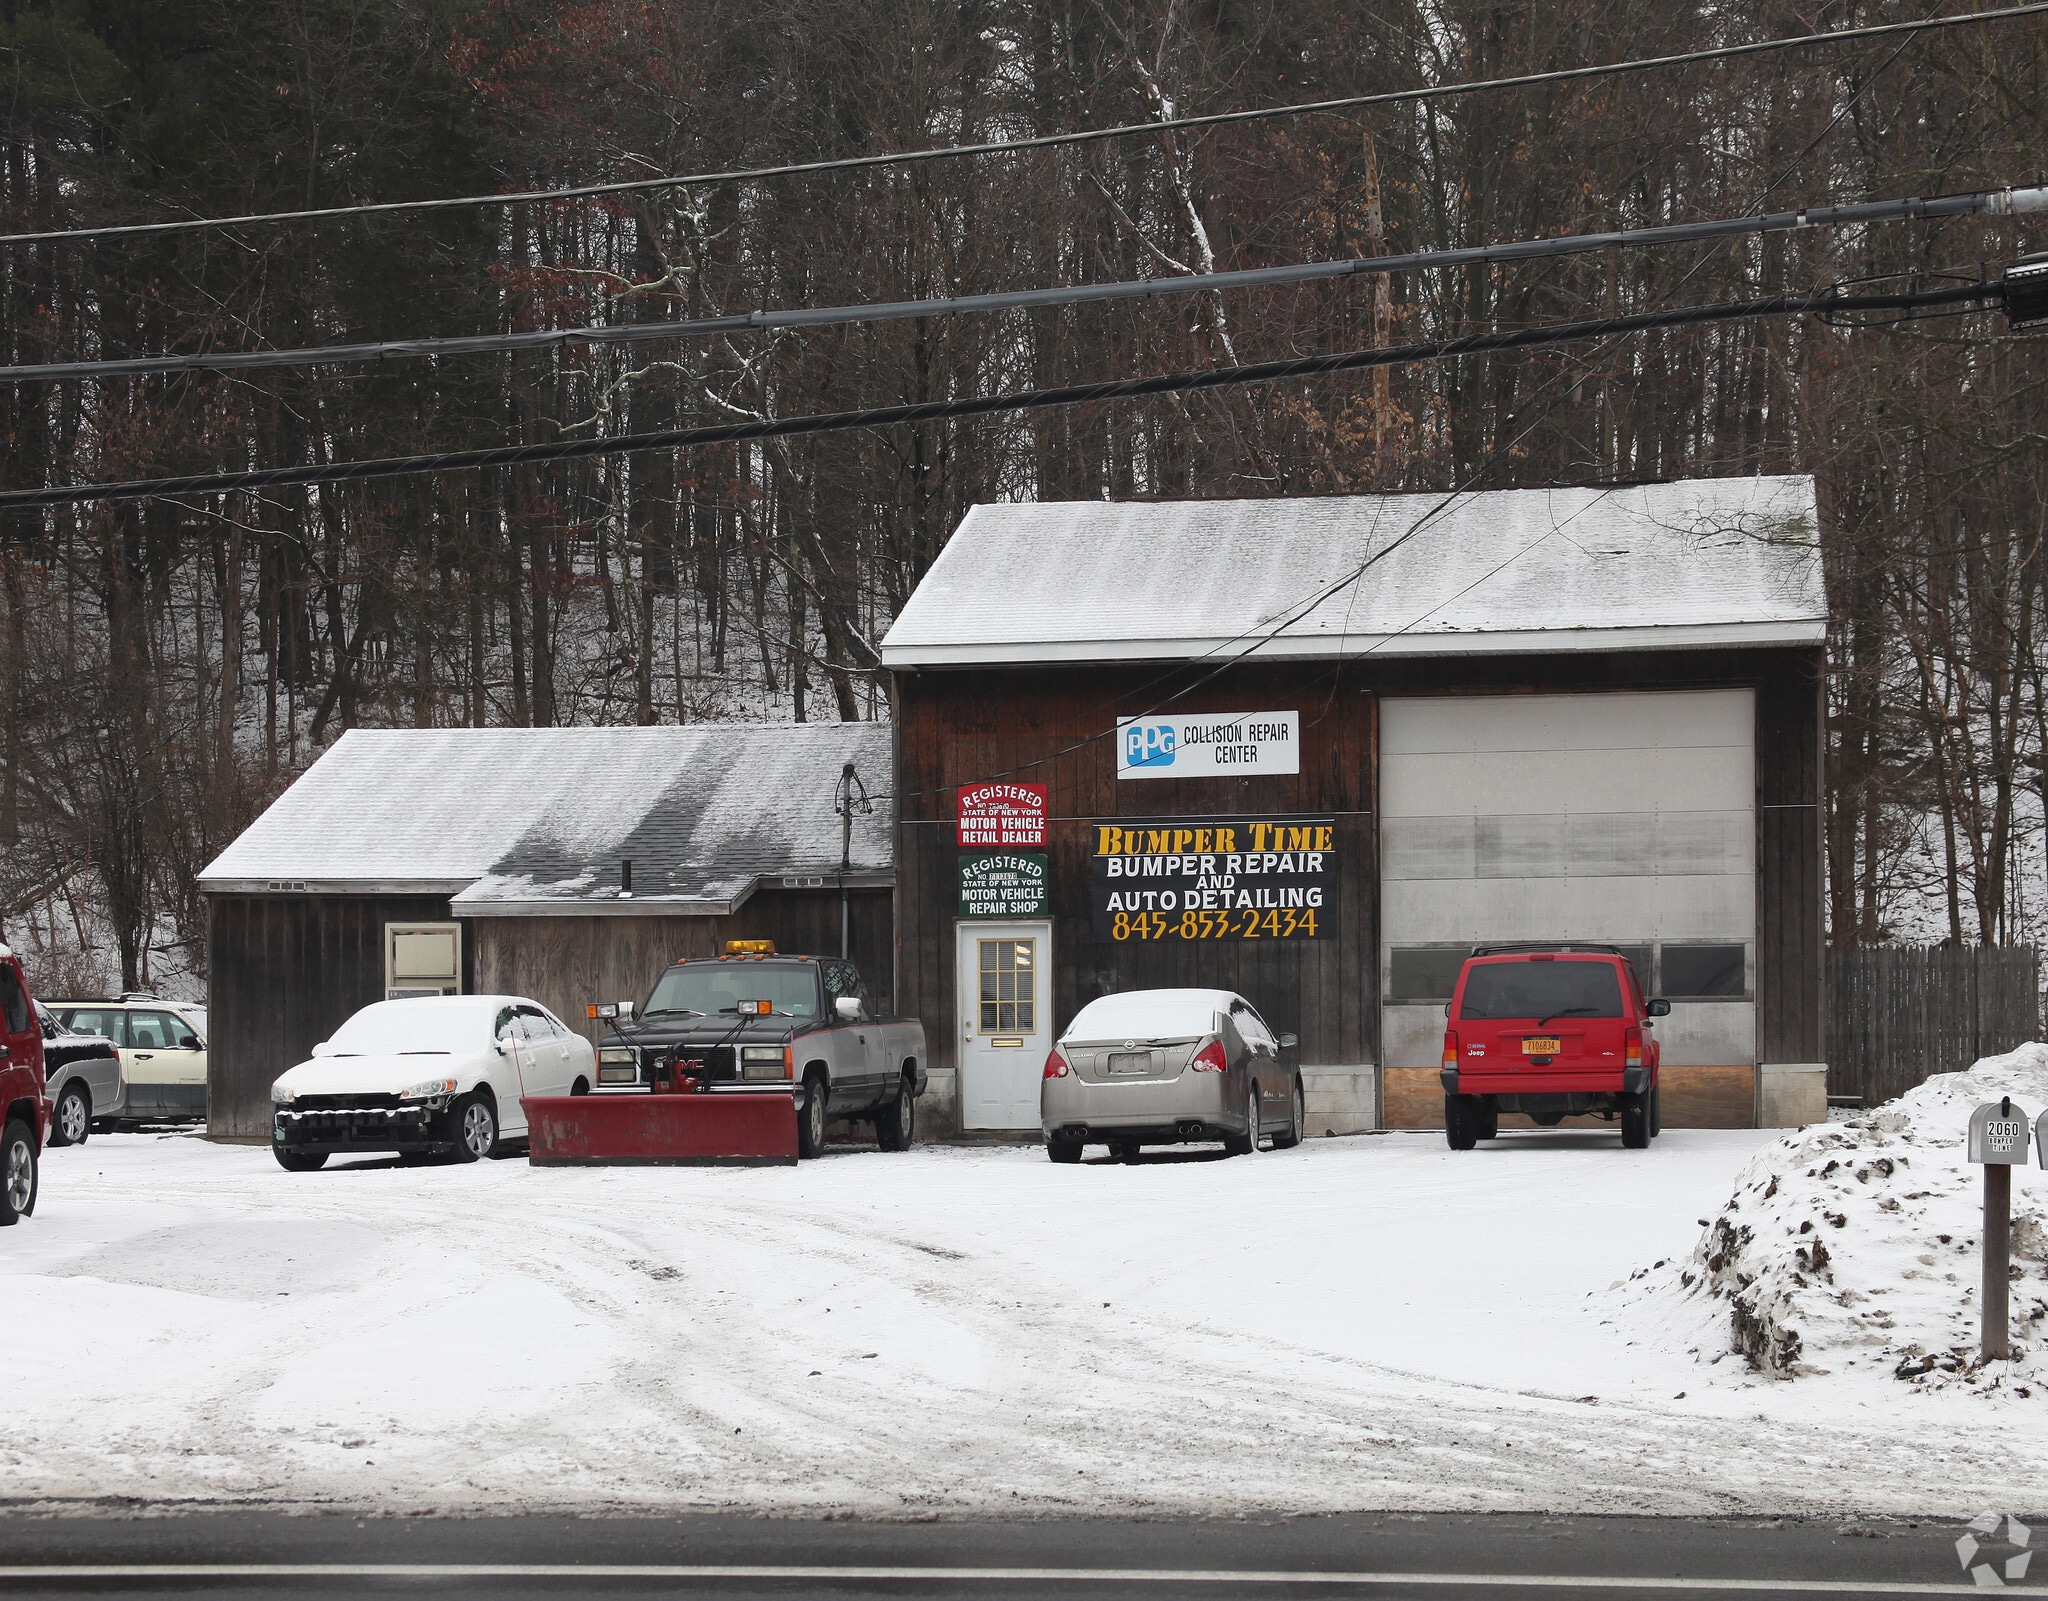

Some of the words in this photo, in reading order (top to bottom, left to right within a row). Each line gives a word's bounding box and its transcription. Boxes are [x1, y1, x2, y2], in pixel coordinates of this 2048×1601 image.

[1128, 725, 1175, 760] PPG
[1184, 724, 1242, 744] COLLISION
[1249, 723, 1289, 741] REPAIR
[1215, 745, 1258, 764] CENTER
[962, 785, 1042, 808] REGISTERED
[960, 817, 997, 830] MOTOR
[1001, 817, 1044, 830] VEHICLE
[962, 831, 999, 843] RETAIL
[1002, 831, 1042, 843] DEALER
[1097, 826, 1237, 855] BUMPER
[1249, 823, 1333, 851] TIME
[962, 856, 1043, 880] REGISTERED
[1107, 855, 1217, 877] BUMPER
[1225, 853, 1324, 875] REPAIR
[1195, 875, 1236, 889] AND
[962, 889, 997, 901] MOTOR
[1000, 888, 1044, 900] VEHICLE
[1106, 890, 1177, 912] AUTO
[1184, 887, 1323, 911] DETAILING
[969, 902, 1006, 914] REPAIR
[1010, 901, 1038, 913] SHOP
[1112, 909, 1319, 941] 845-853-2434
[1528, 1041, 1555, 1050] 7106834
[674, 1059, 704, 1069] MC
[1988, 1122, 2018, 1136] 2060
